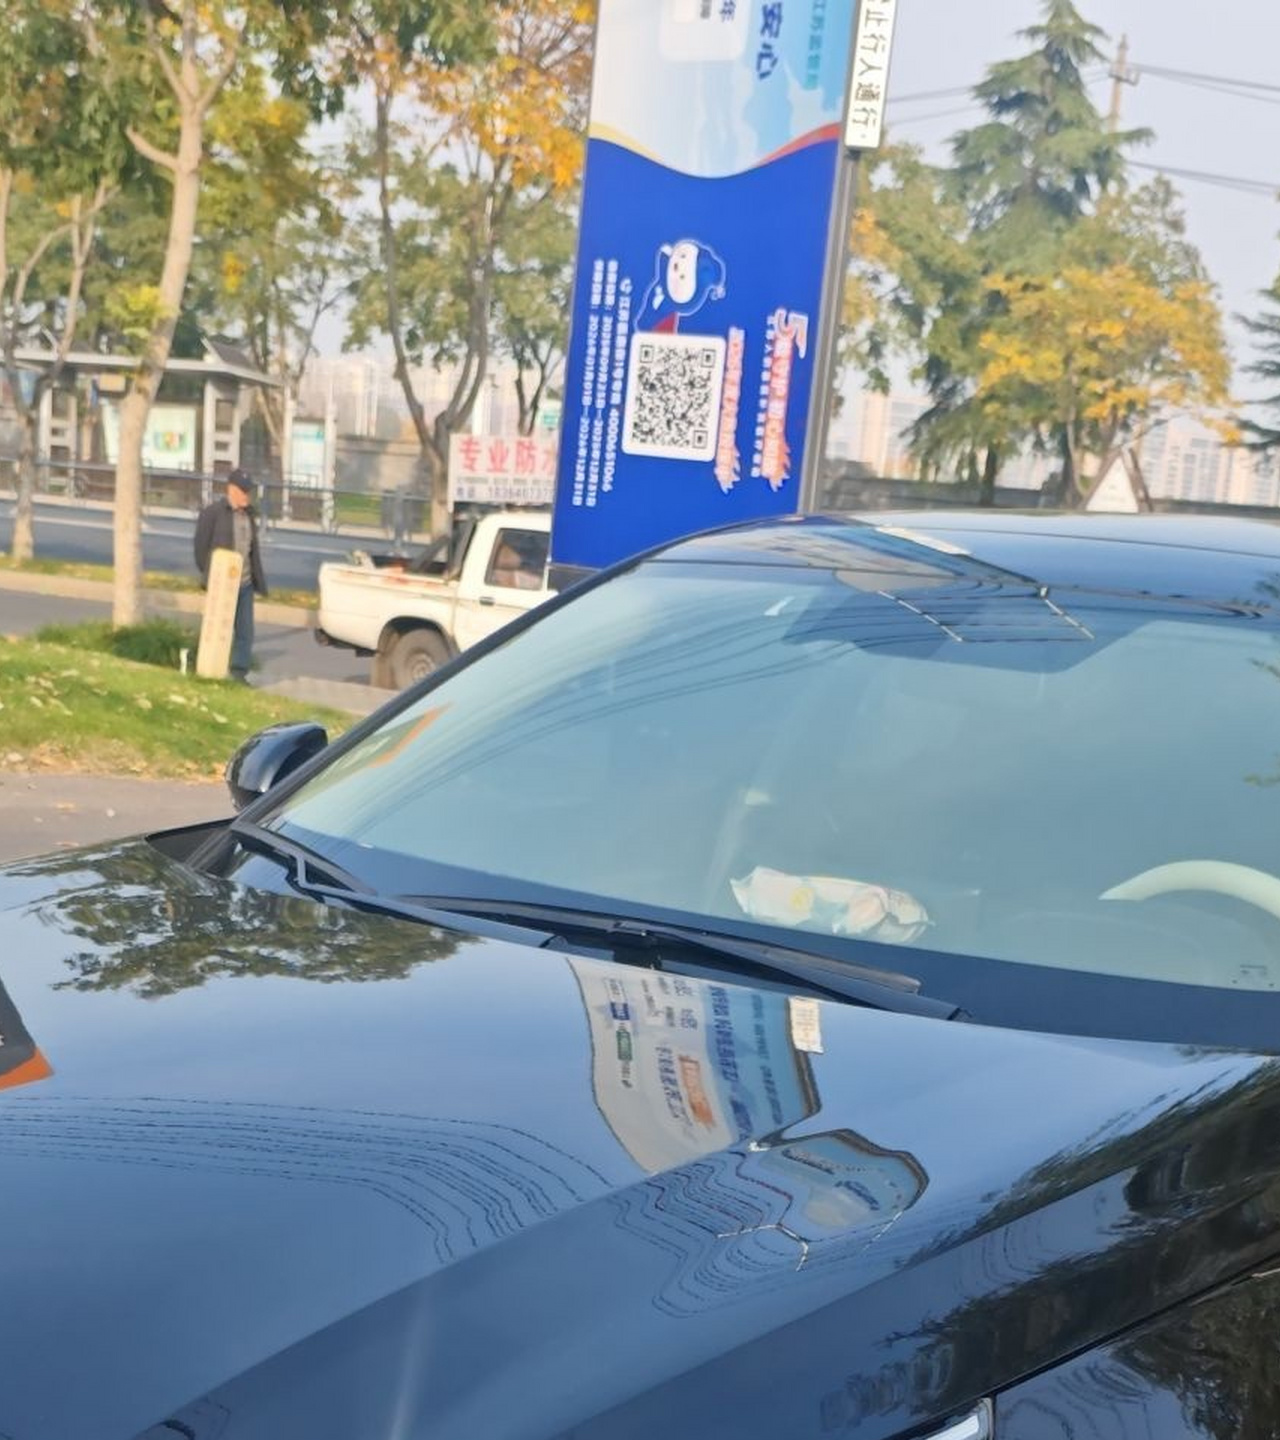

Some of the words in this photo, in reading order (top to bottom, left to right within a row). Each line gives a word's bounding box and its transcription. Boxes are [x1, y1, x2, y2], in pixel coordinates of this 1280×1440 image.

[852, 0, 892, 129] 止行人通行
[601, 408, 619, 492] 4000651066
